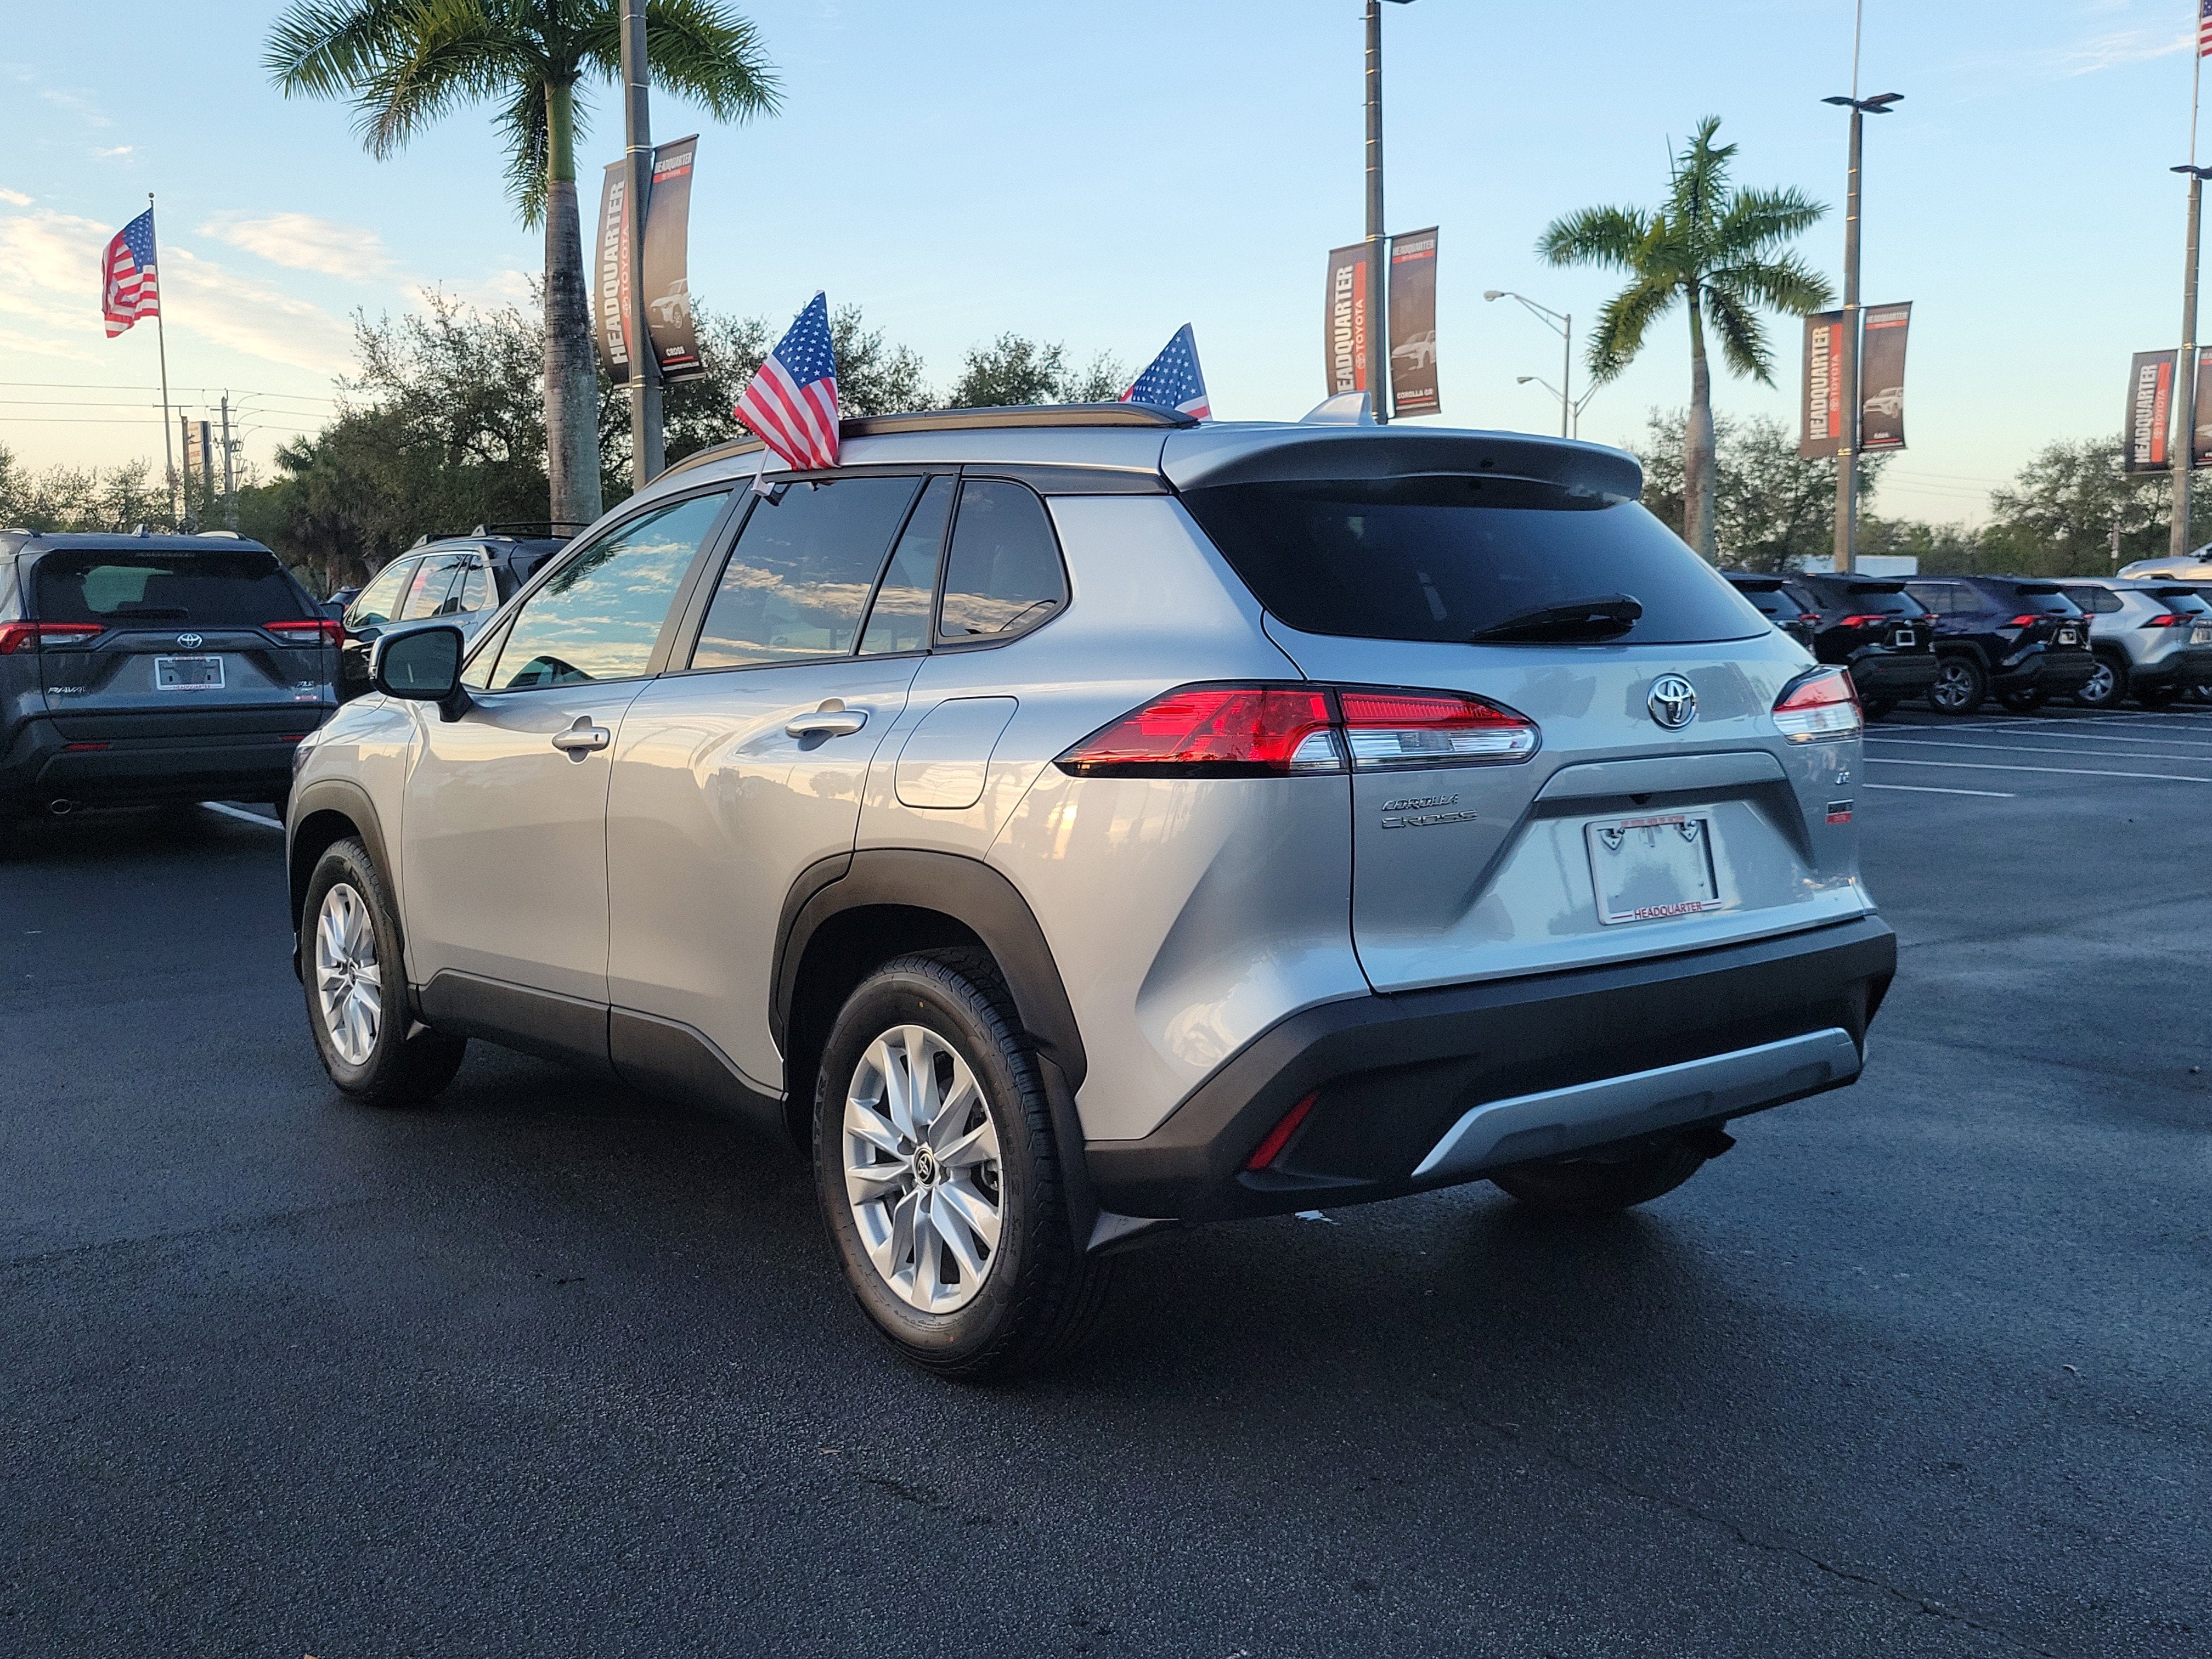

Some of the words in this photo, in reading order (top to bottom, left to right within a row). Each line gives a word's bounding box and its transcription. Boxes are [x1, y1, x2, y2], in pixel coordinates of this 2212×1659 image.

[654, 152, 692, 174] HEADQUARTER
[603, 179, 629, 364] HEADQUARTER
[620, 225, 629, 292] TOYOTA
[1334, 265, 1354, 392] EADQUARTER
[1355, 298, 1364, 351] TOYOTA
[1810, 326, 1830, 439] HEADQUARTER
[1830, 354, 1841, 396] TOYOTA
[2134, 363, 2158, 462] HEADQUARTER
[2154, 389, 2165, 426] TOYOTA
[1381, 794, 1459, 811] COROLLA
[1381, 809, 1477, 829] CROSS
[1634, 901, 1702, 919] HEADQUARTER
